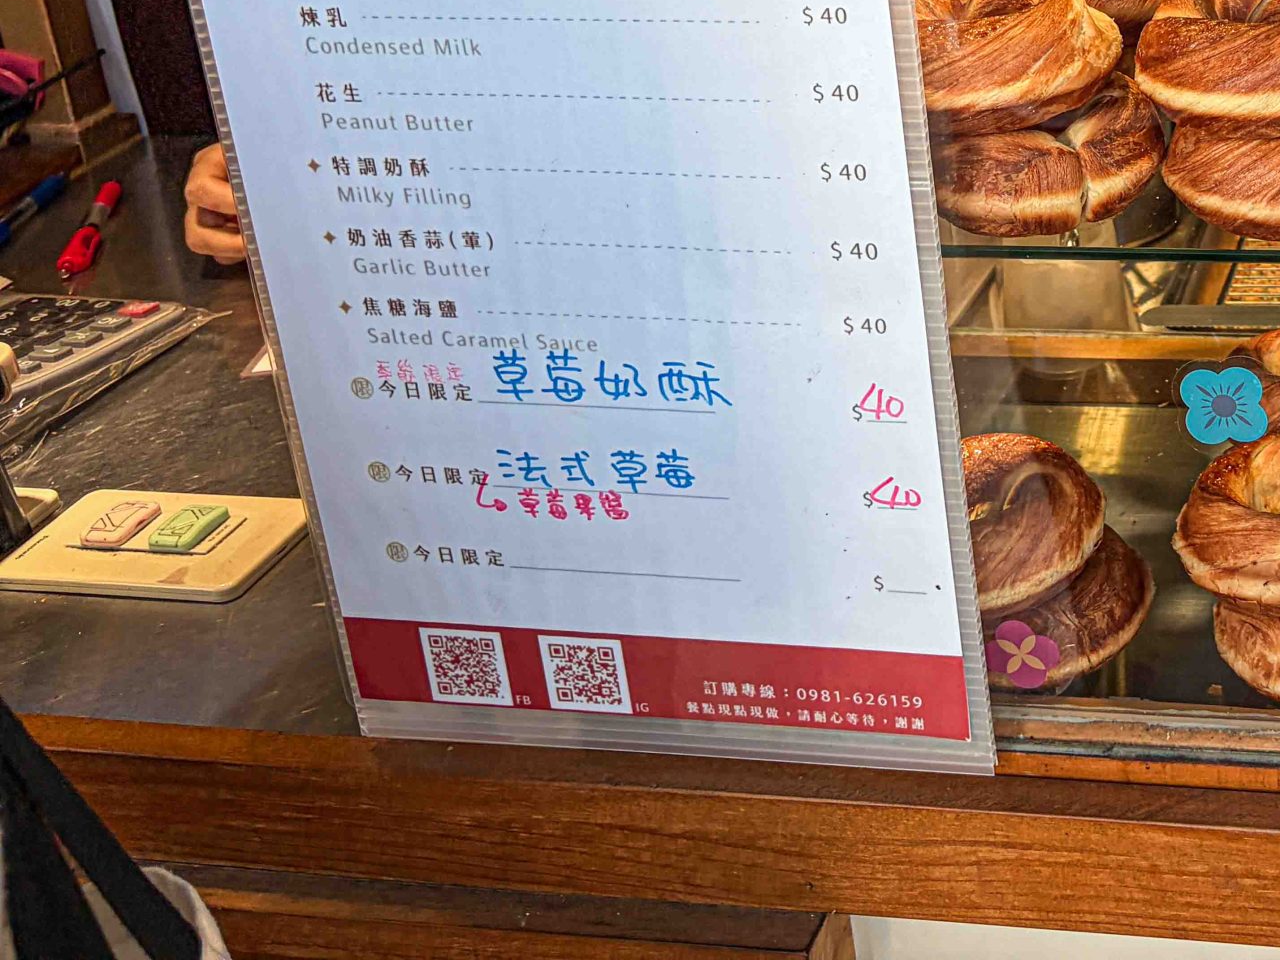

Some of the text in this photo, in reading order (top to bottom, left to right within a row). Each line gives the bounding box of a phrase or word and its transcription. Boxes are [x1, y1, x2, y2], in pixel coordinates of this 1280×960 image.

[299, 5, 348, 29] 煉乳
[305, 36, 483, 58] Condensed Milk
[315, 83, 364, 104] 花生
[321, 112, 475, 133] Peanut Butter
[332, 155, 431, 178] 特調奶酥
[337, 186, 473, 210] Milky Filling
[353, 257, 492, 279] Garlic Butter
[362, 297, 459, 319] 焦糖海鹽
[367, 327, 599, 353] Salted Caramel Sauce
[492, 348, 733, 406] 草莓奶酥
[378, 380, 473, 402] 今日限定
[395, 464, 489, 486] 今日限定
[496, 448, 696, 493] 法式草莓
[413, 544, 505, 567] 今日限定
[515, 695, 532, 706] FB
[635, 702, 650, 713] IG
